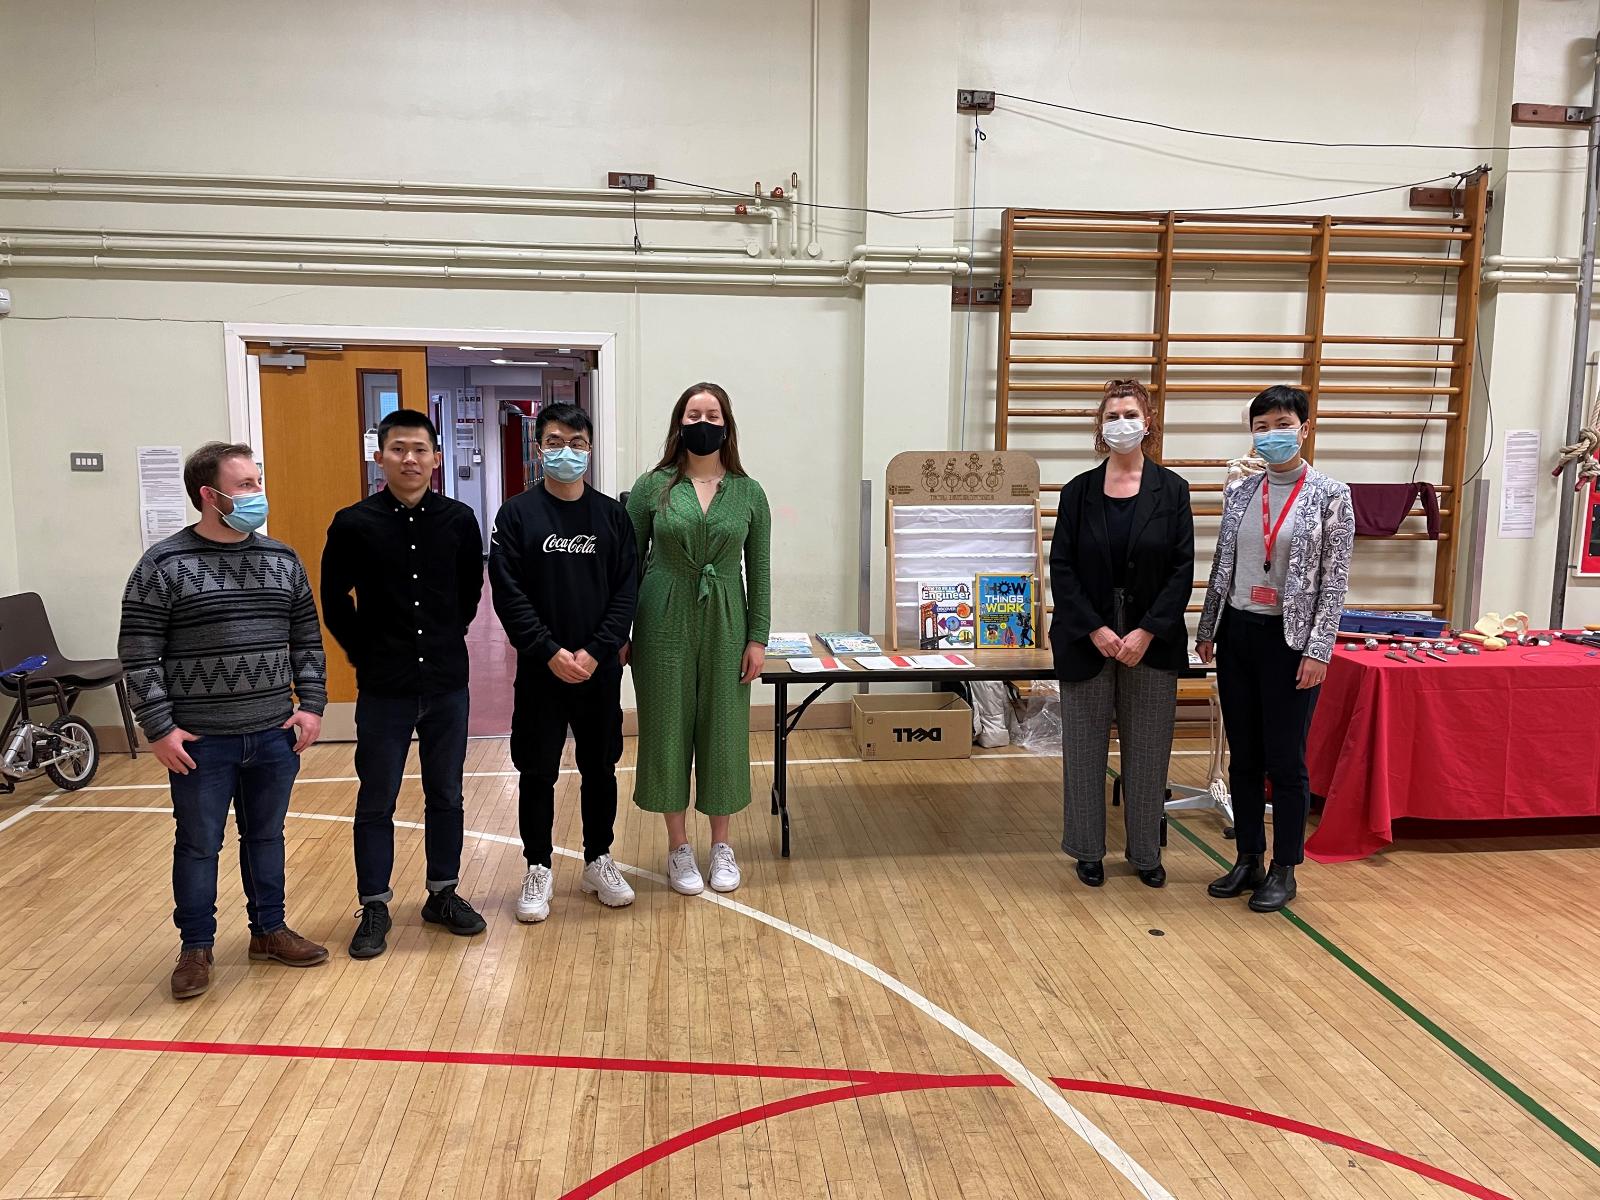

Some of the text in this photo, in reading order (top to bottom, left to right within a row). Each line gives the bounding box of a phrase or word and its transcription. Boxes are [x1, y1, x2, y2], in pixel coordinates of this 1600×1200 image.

[985, 581, 1026, 595] HOW
[922, 591, 970, 602] Engineer
[985, 595, 1024, 603] THINGS
[986, 603, 1026, 613] WORK
[892, 727, 942, 742] DELL
